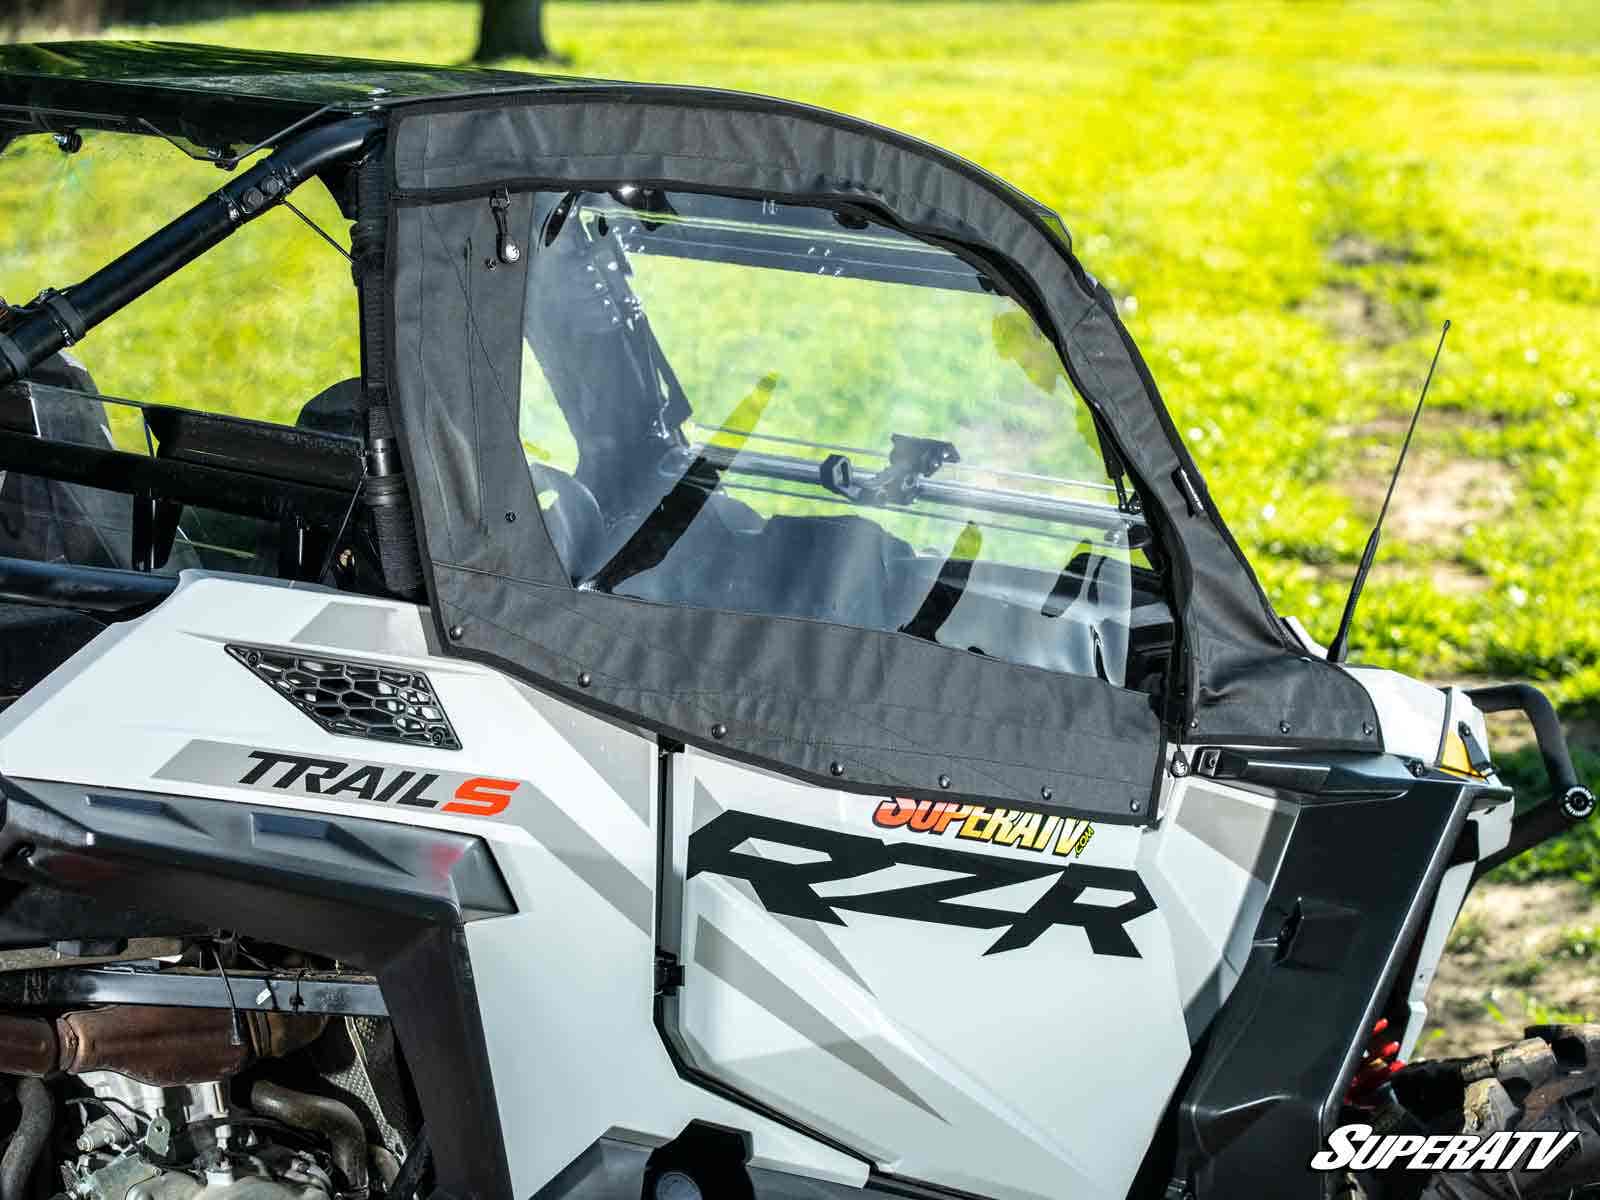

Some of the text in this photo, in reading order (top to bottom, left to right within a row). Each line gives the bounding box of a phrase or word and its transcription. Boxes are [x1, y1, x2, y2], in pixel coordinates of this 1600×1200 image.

[238, 750, 521, 817] TRAIL S
[686, 809, 1158, 958] RZR
